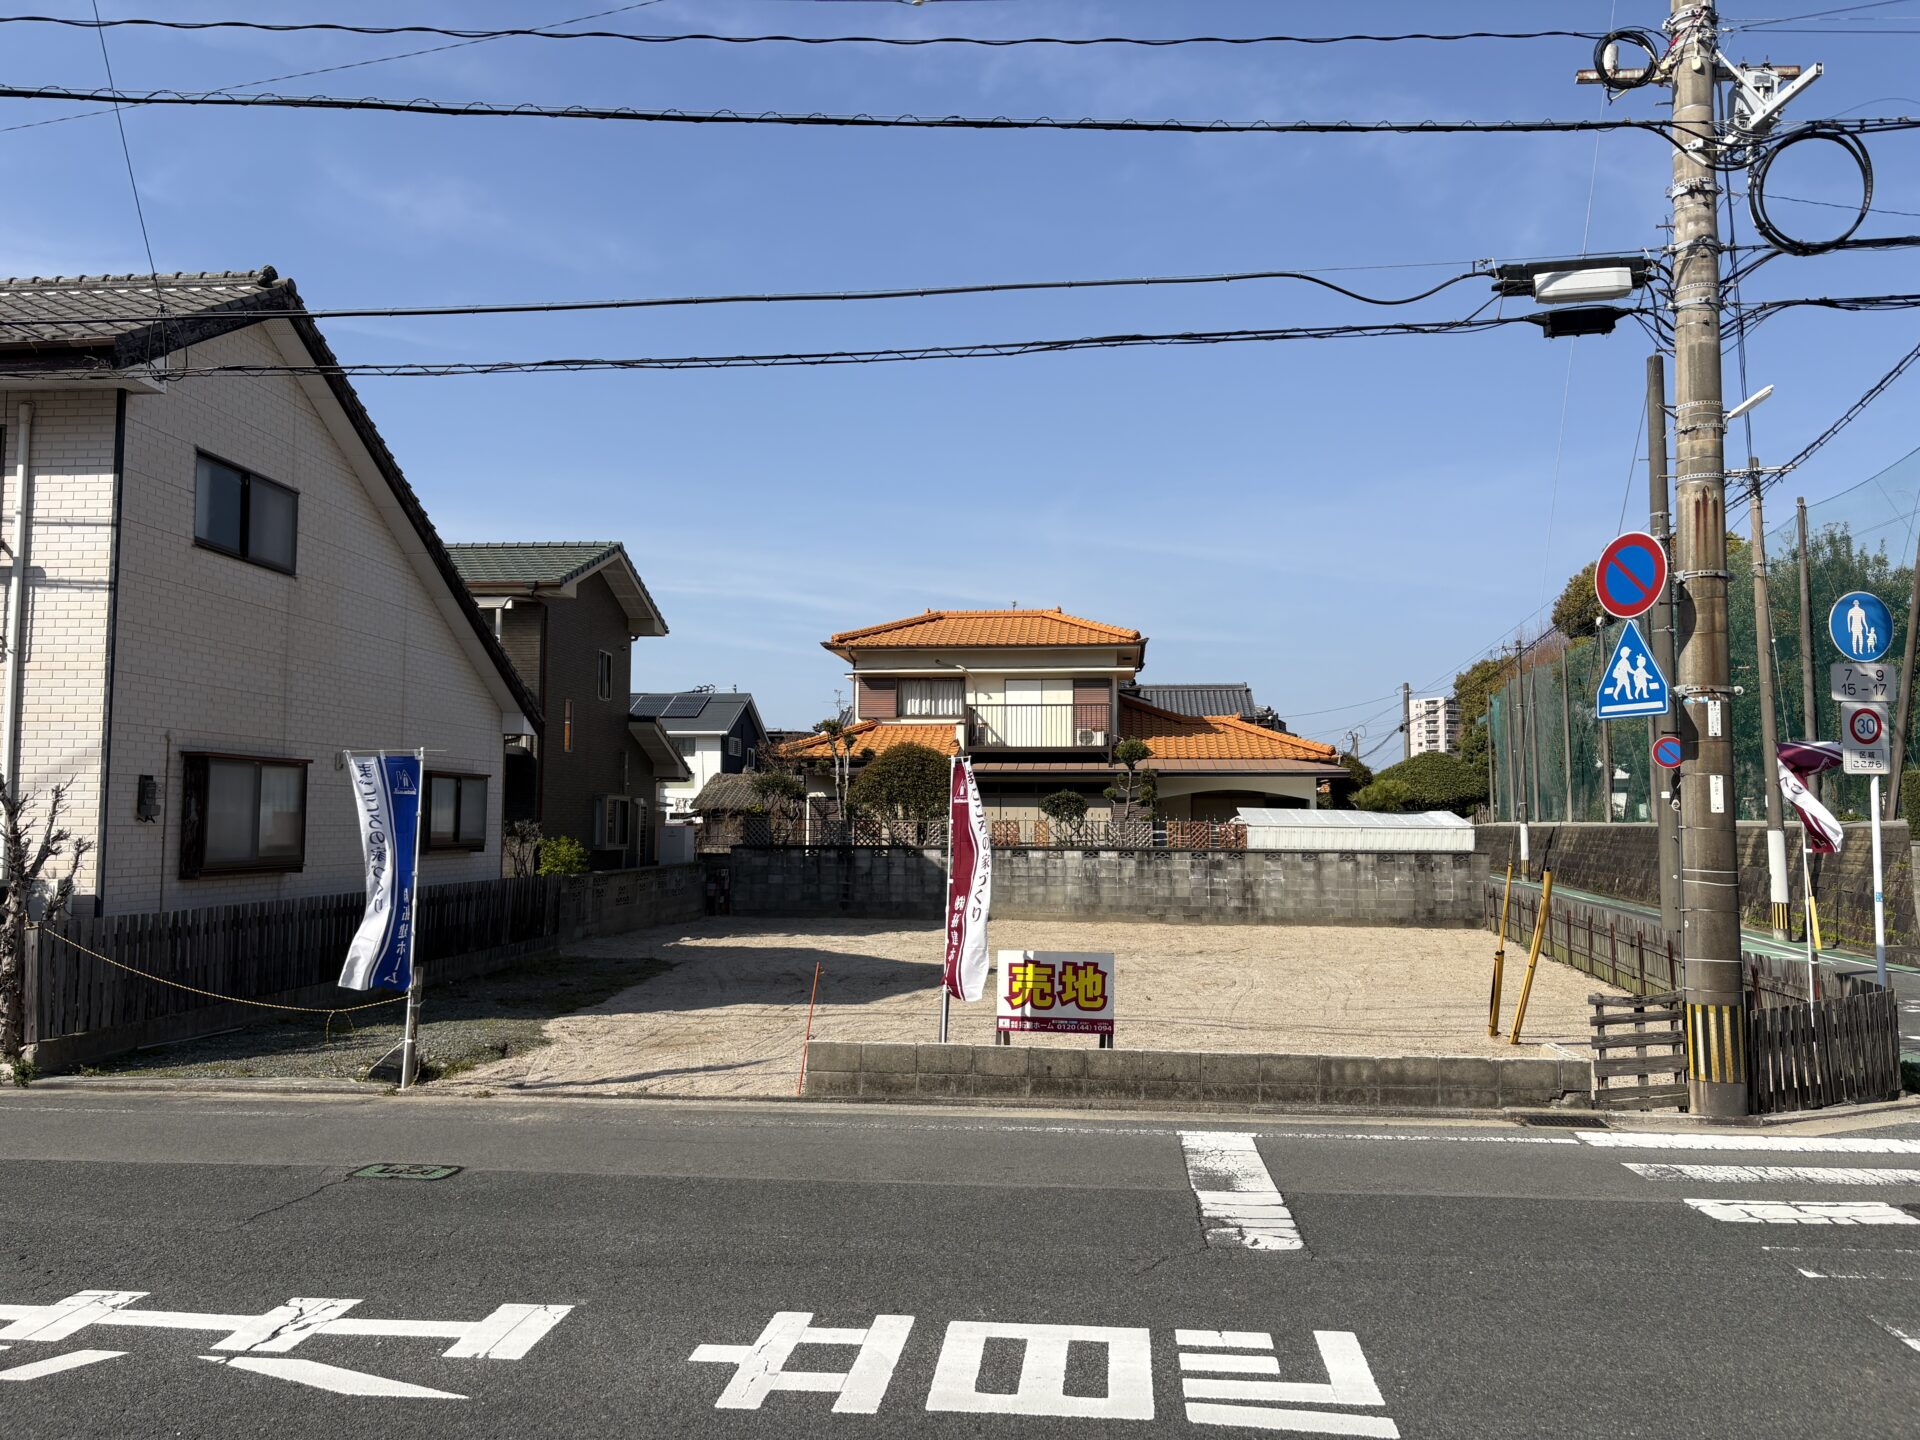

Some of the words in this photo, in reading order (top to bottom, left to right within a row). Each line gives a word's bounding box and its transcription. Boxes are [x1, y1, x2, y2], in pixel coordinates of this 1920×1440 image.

[1857, 718, 1875, 735] 30
[1853, 760, 1882, 768] ここから
[1004, 960, 1108, 1012] 売地
